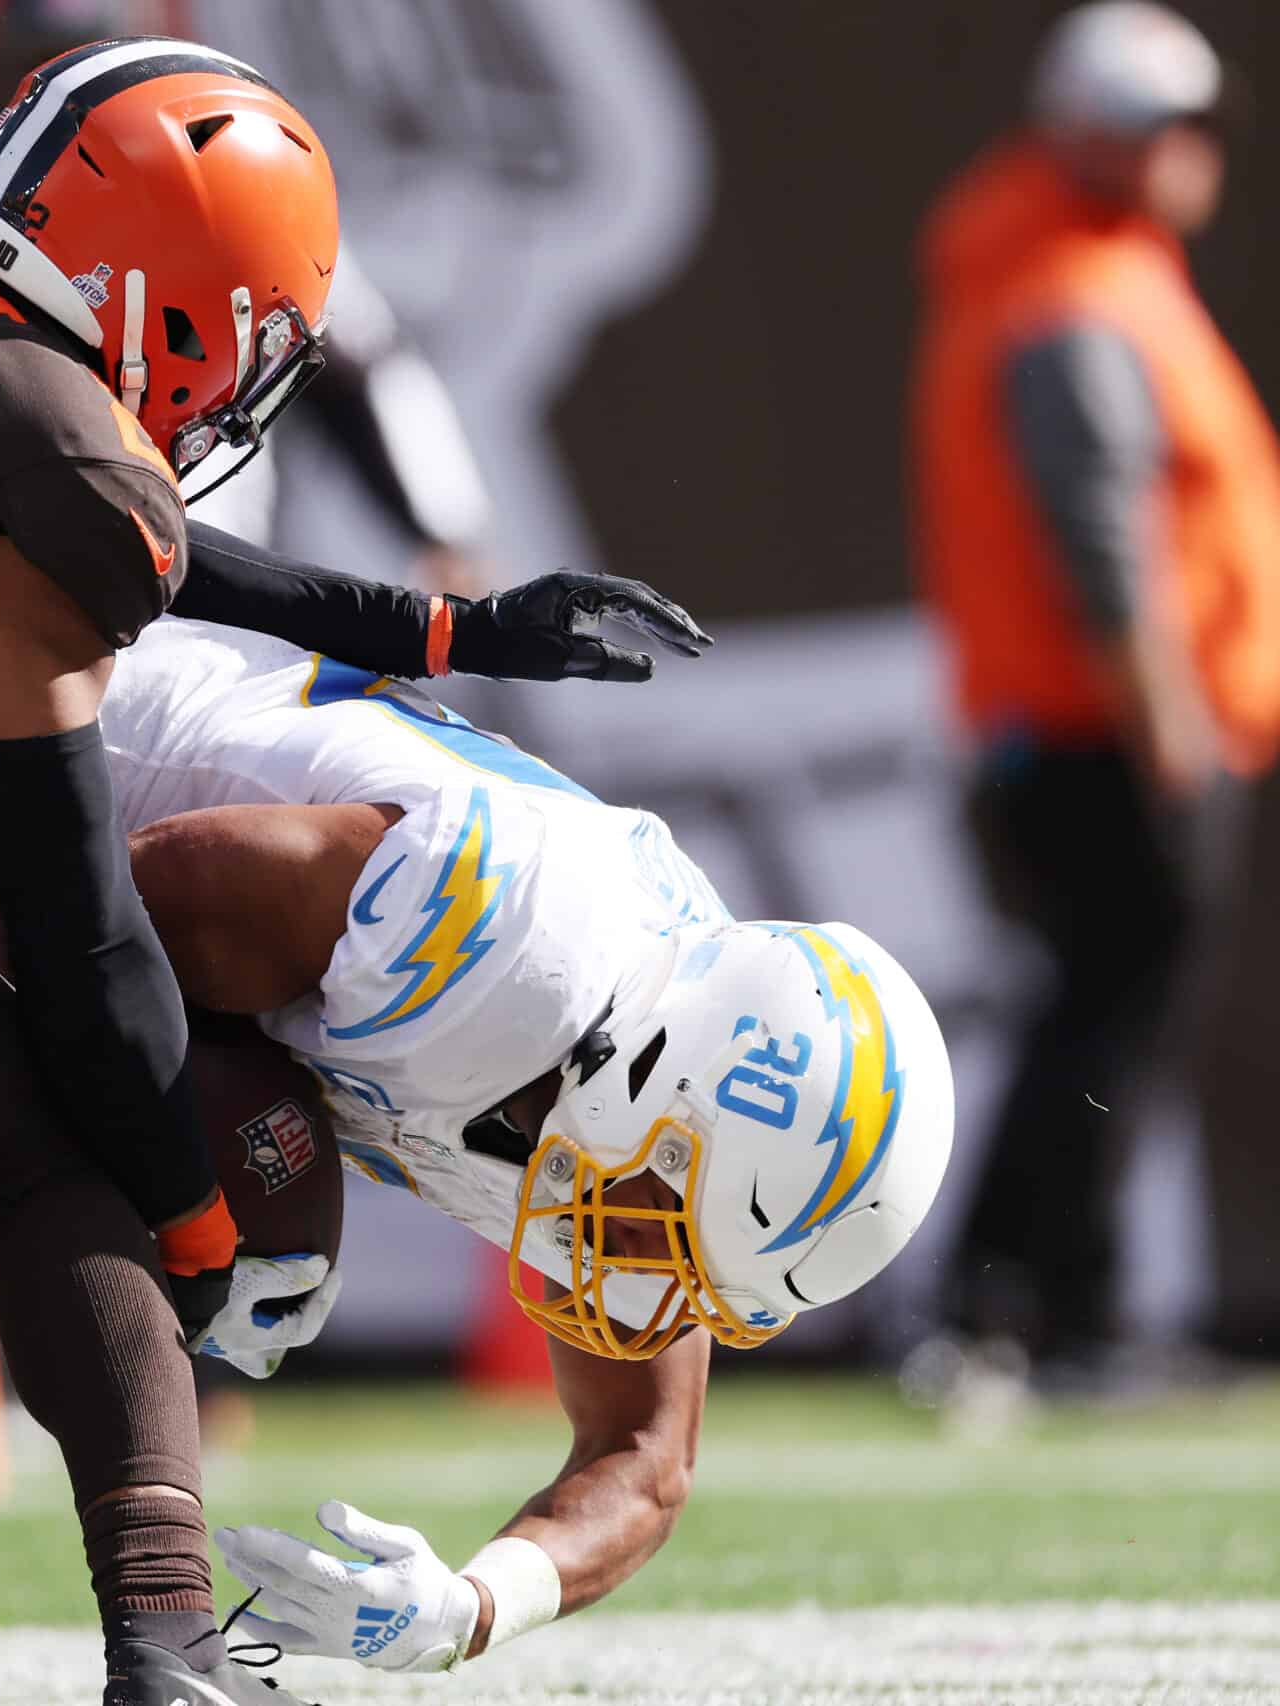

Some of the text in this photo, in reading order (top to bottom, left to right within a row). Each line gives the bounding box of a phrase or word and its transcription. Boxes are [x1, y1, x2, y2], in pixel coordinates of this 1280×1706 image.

[71, 276, 108, 304] CATCH
[716, 1015, 813, 1131] 30
[270, 1106, 314, 1172] NFL
[354, 1603, 418, 1658] adidas
